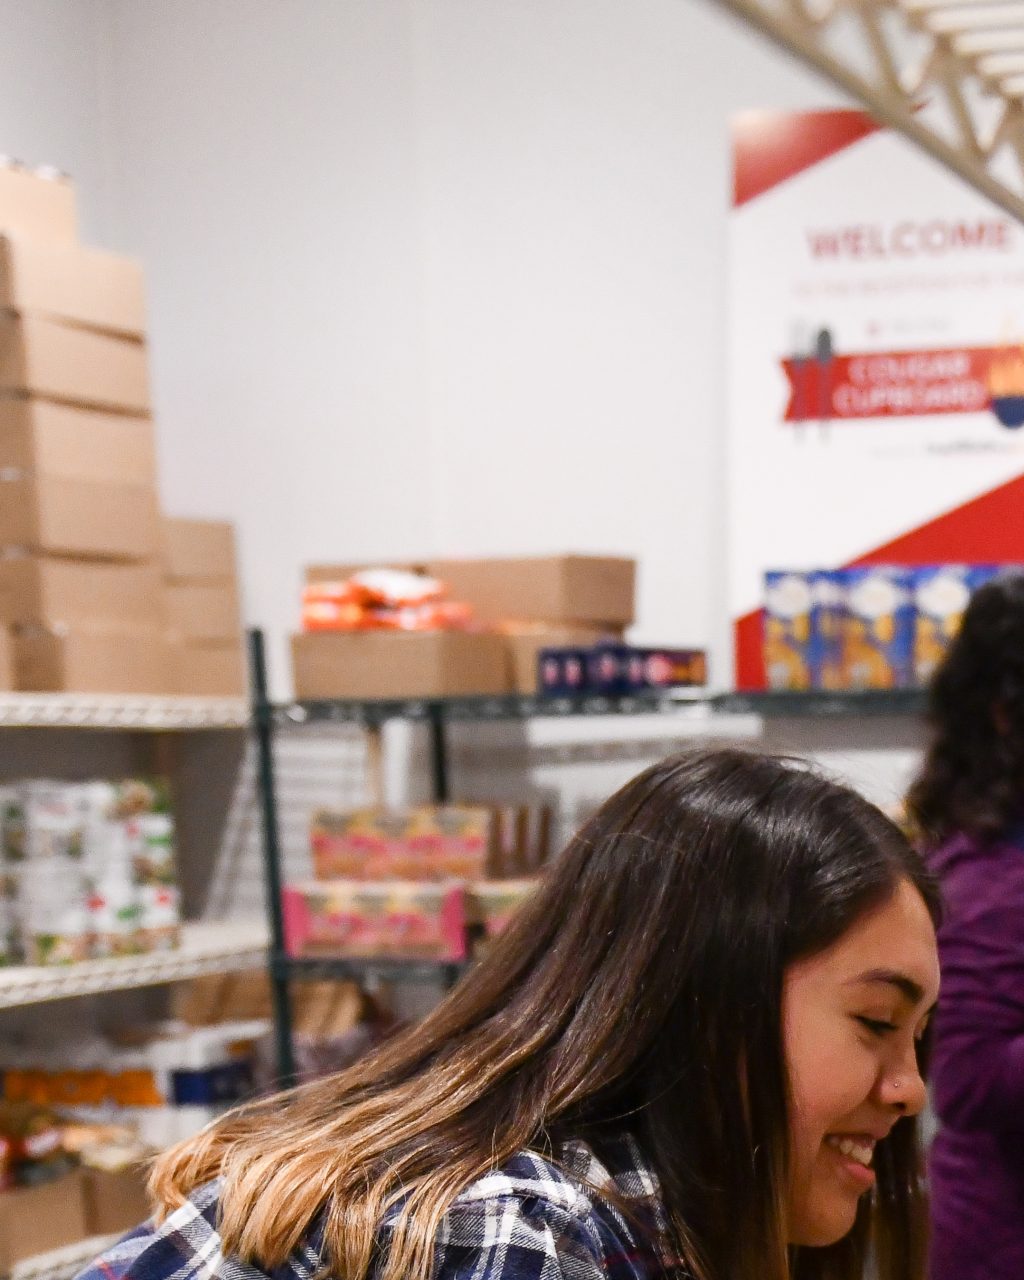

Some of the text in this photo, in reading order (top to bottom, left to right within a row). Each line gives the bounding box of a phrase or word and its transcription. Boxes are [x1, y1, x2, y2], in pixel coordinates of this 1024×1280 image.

[808, 221, 1011, 258] WELCOME
[851, 355, 967, 384] COUGAR
[836, 382, 985, 410] CUPBOARD
